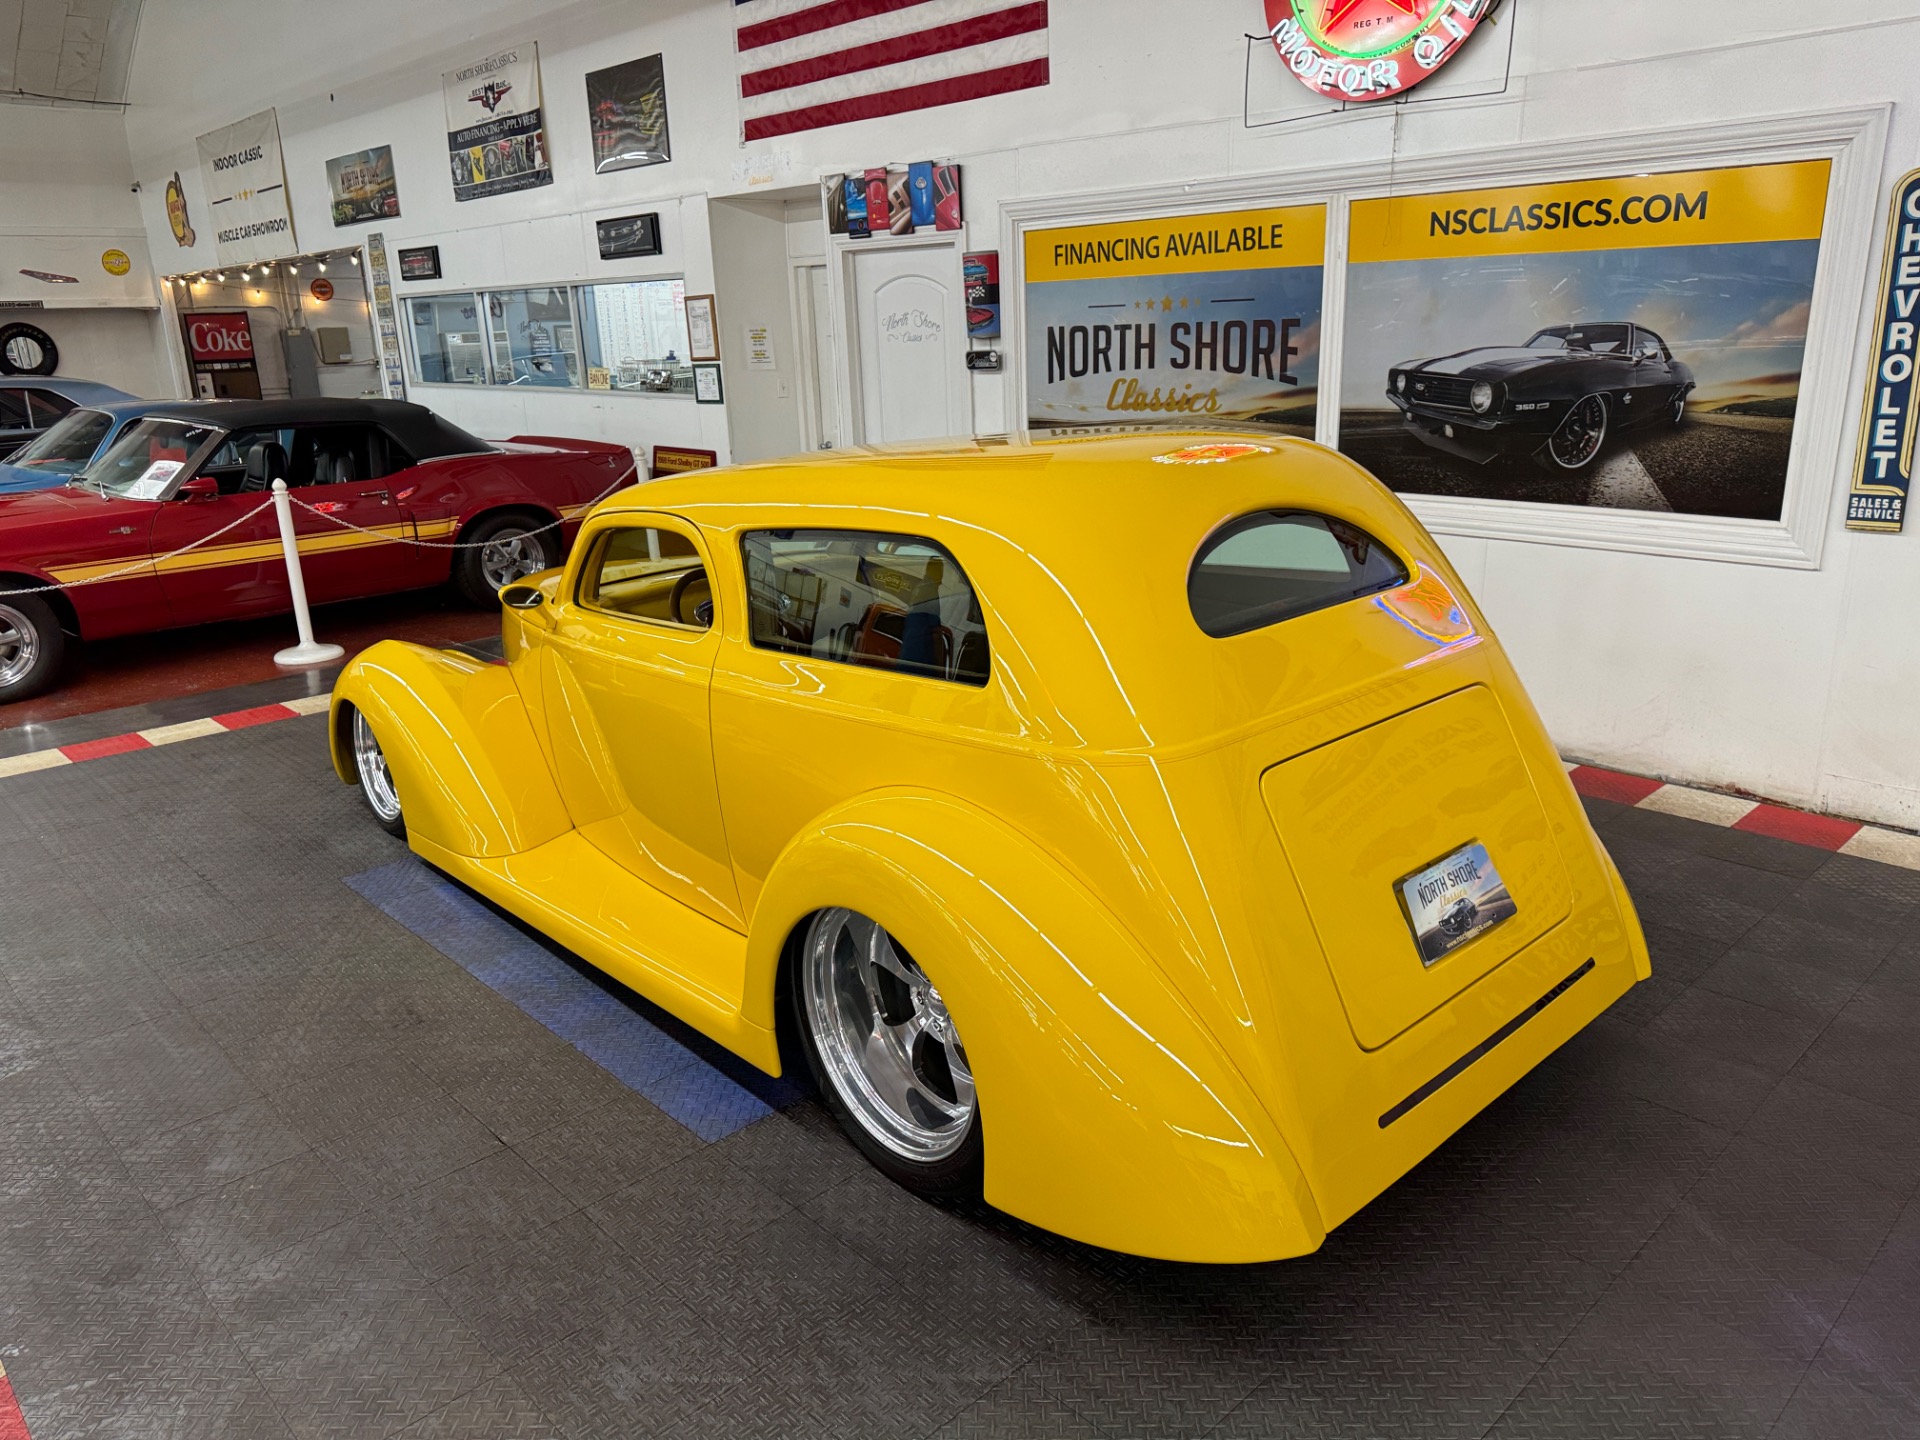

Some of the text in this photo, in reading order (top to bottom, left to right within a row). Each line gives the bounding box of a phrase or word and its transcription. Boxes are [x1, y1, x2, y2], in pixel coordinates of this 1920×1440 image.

[1353, 19, 1372, 29] REG
[455, 50, 518, 83] NORTH SHORE CLASSICS
[1270, 18, 1402, 96] MOTOR
[471, 87, 484, 97] BEST
[456, 132, 473, 144] AUTO
[471, 122, 500, 141] FINANCING
[502, 117, 523, 131] APPLY
[522, 111, 538, 125] HERE
[212, 144, 263, 173] INDOOR CLASSIC
[1429, 190, 1709, 237] NSCLASSICS.COM
[217, 216, 288, 245] MUSCLE CAR SHOWROOM
[1054, 223, 1284, 267] FINANCING AVAILABLE
[189, 322, 252, 353] Coke
[1047, 317, 1301, 387] NORTH SHORE
[1870, 193, 1920, 481] CHEVROLET
[1106, 377, 1222, 414] Classics
[667, 456, 678, 466] Ford
[677, 457, 693, 469] Shelby
[1849, 506, 1901, 521] SERVICE
[1851, 496, 1902, 511] SALES &
[1417, 859, 1482, 910] NORTH SHORE
